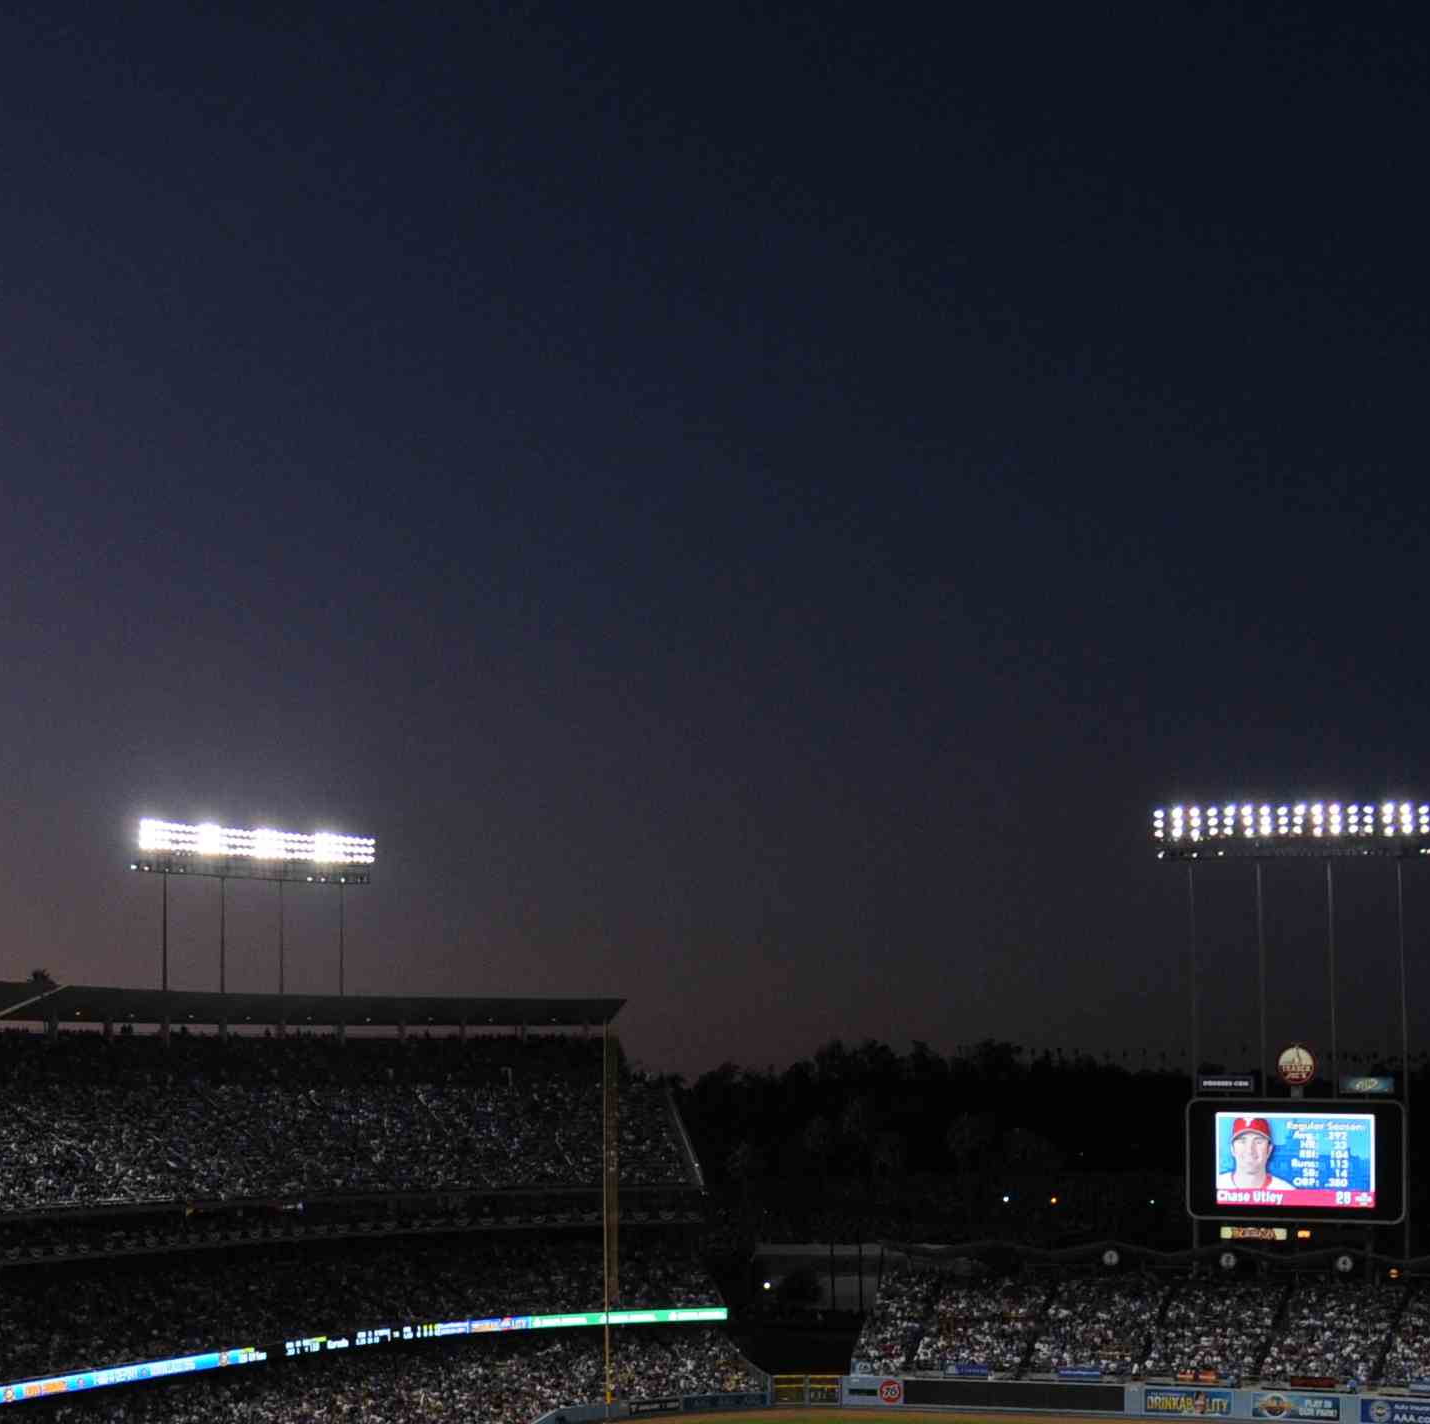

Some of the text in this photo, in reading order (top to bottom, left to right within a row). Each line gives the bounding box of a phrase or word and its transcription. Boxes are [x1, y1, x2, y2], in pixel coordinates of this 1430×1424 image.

[1291, 1158, 1320, 1168] Runs:
[1217, 1190, 1251, 1202] Chase
[1252, 1191, 1284, 1204] Utley
[882, 1386, 901, 1398] 76
